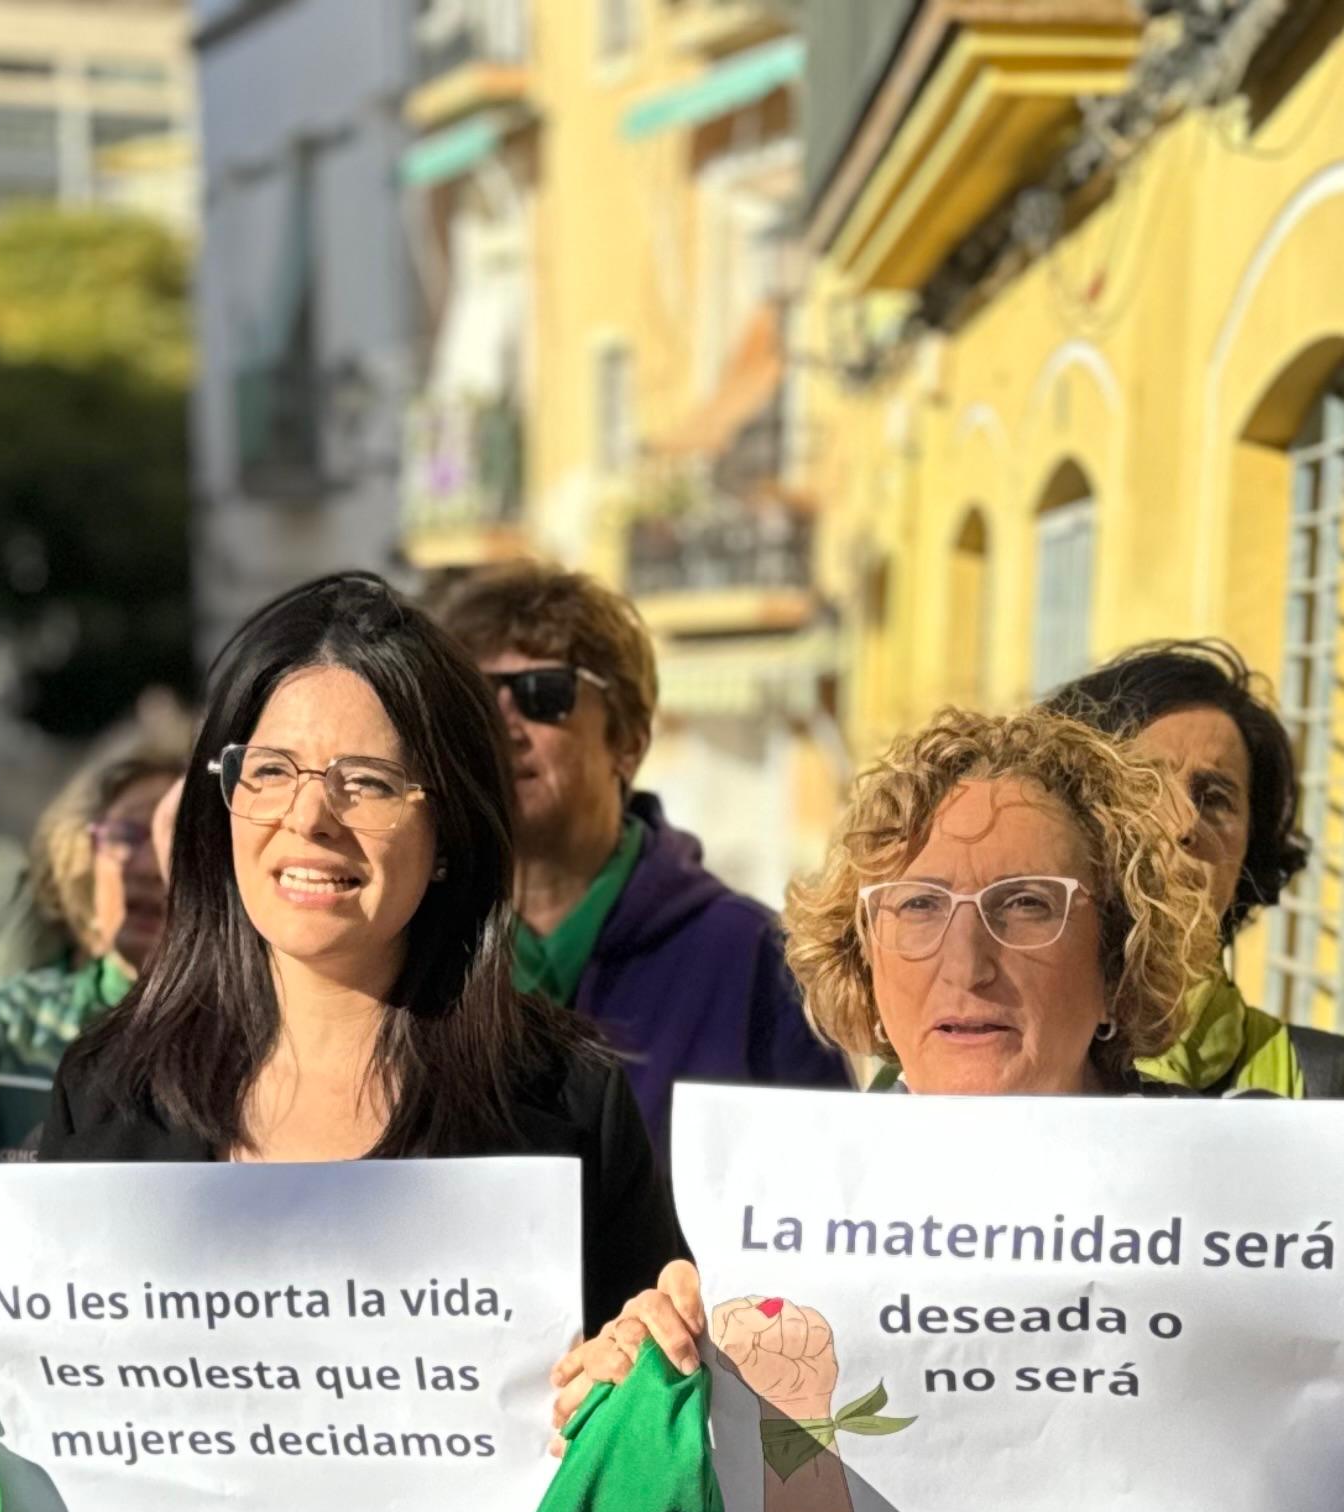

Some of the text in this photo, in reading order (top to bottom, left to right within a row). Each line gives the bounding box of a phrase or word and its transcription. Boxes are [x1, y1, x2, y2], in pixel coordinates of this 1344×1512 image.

[742, 1205, 1334, 1270] La maternidad será
[67, 1283, 128, 1319] les
[144, 1282, 329, 1329] importa
[347, 1279, 385, 1317] la
[400, 1278, 512, 1322] vida,
[879, 1294, 1182, 1339] deseada o
[40, 1356, 479, 1399] les molesta que las
[925, 1362, 1138, 1397] no será
[51, 1422, 495, 1466] mujeres decidamos
